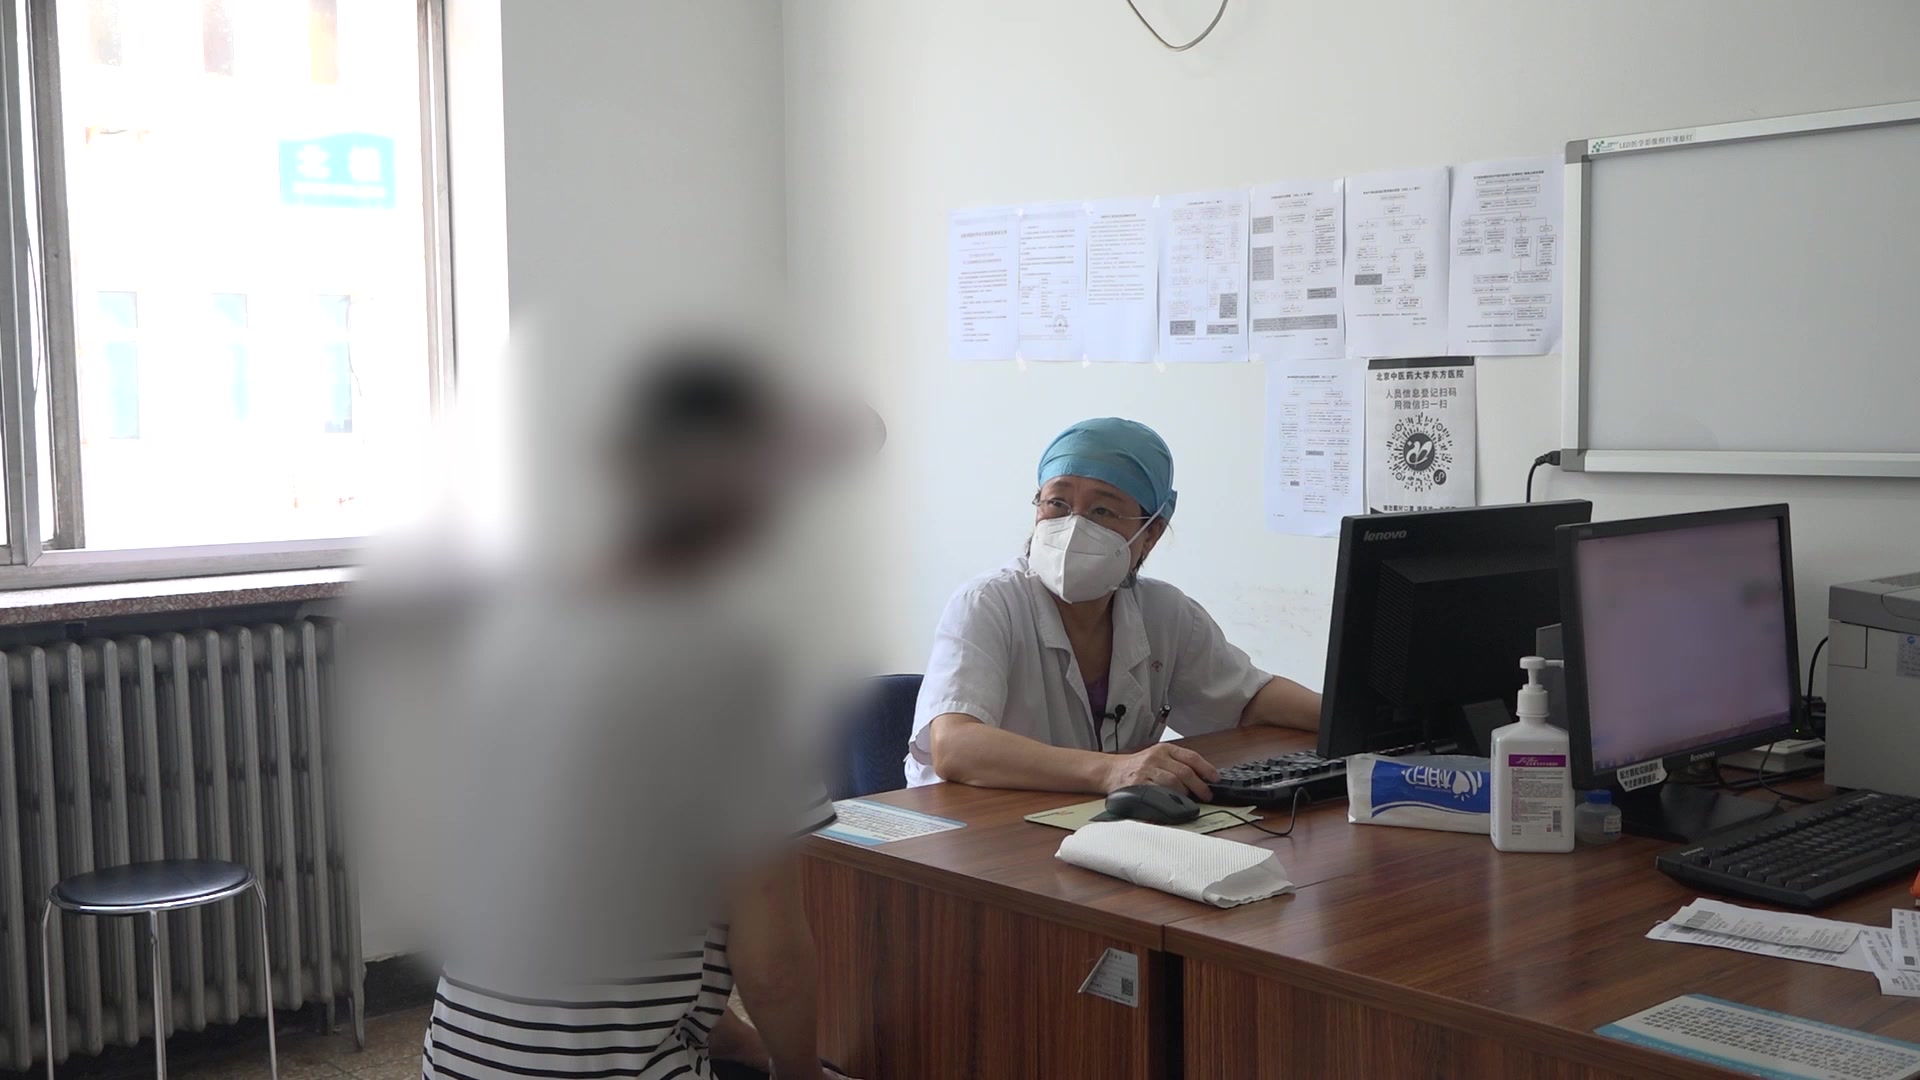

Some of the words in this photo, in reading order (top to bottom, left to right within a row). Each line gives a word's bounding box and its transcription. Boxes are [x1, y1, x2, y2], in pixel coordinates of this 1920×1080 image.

[1376, 369, 1464, 381] 北京中医药大学东方医院
[1385, 387, 1457, 399] 人员信息登记扫码
[1394, 399, 1448, 410] 用微信扫一扫
[1363, 529, 1408, 542] lenovo
[1690, 750, 1716, 763] lenovo
